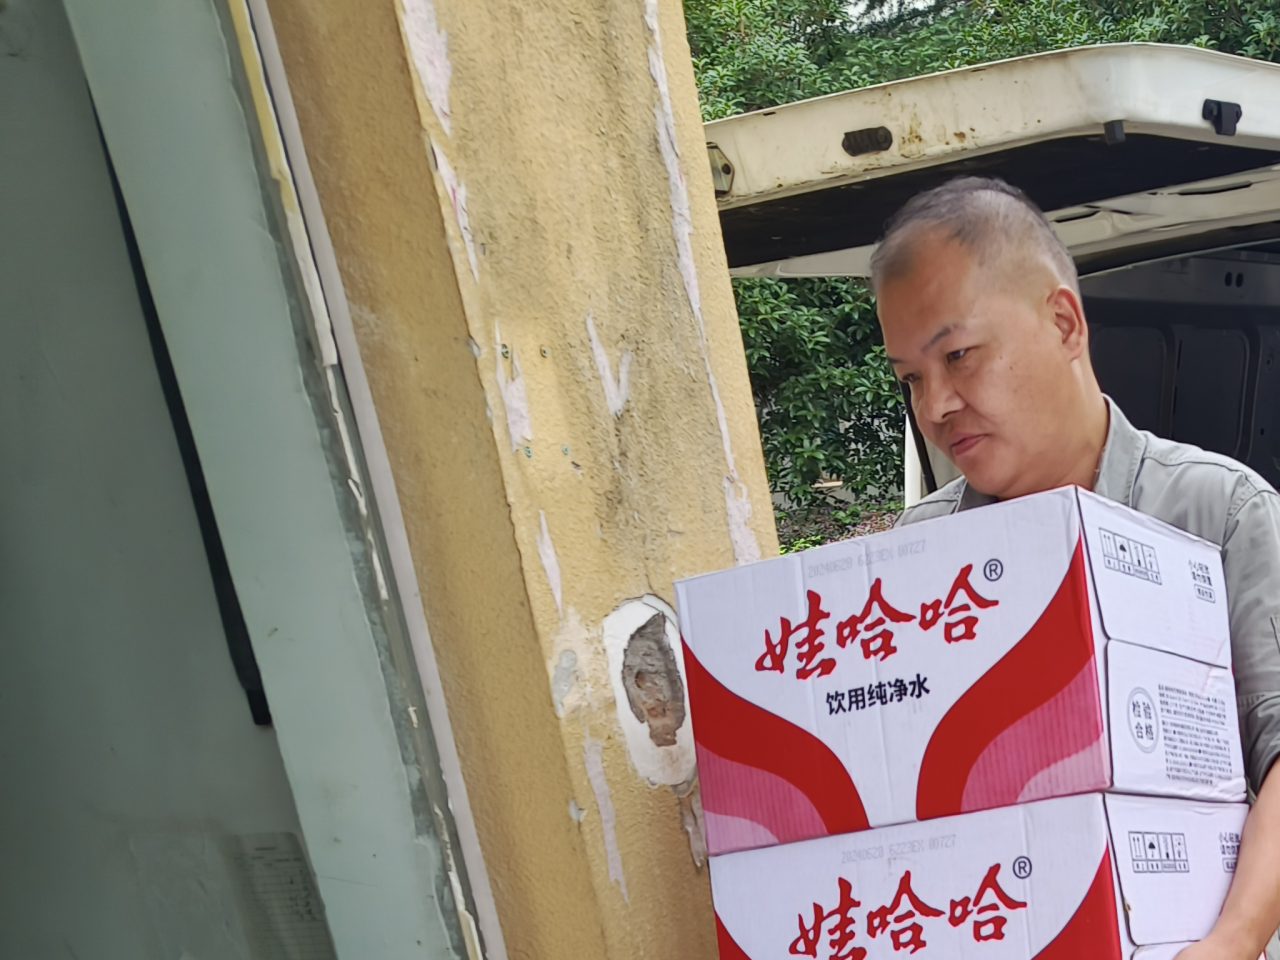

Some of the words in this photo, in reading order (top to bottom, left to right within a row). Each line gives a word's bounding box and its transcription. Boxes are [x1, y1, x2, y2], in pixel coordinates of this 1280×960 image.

[755, 563, 999, 680] 娃哈哈
[825, 674, 930, 716] 饮用纯净水
